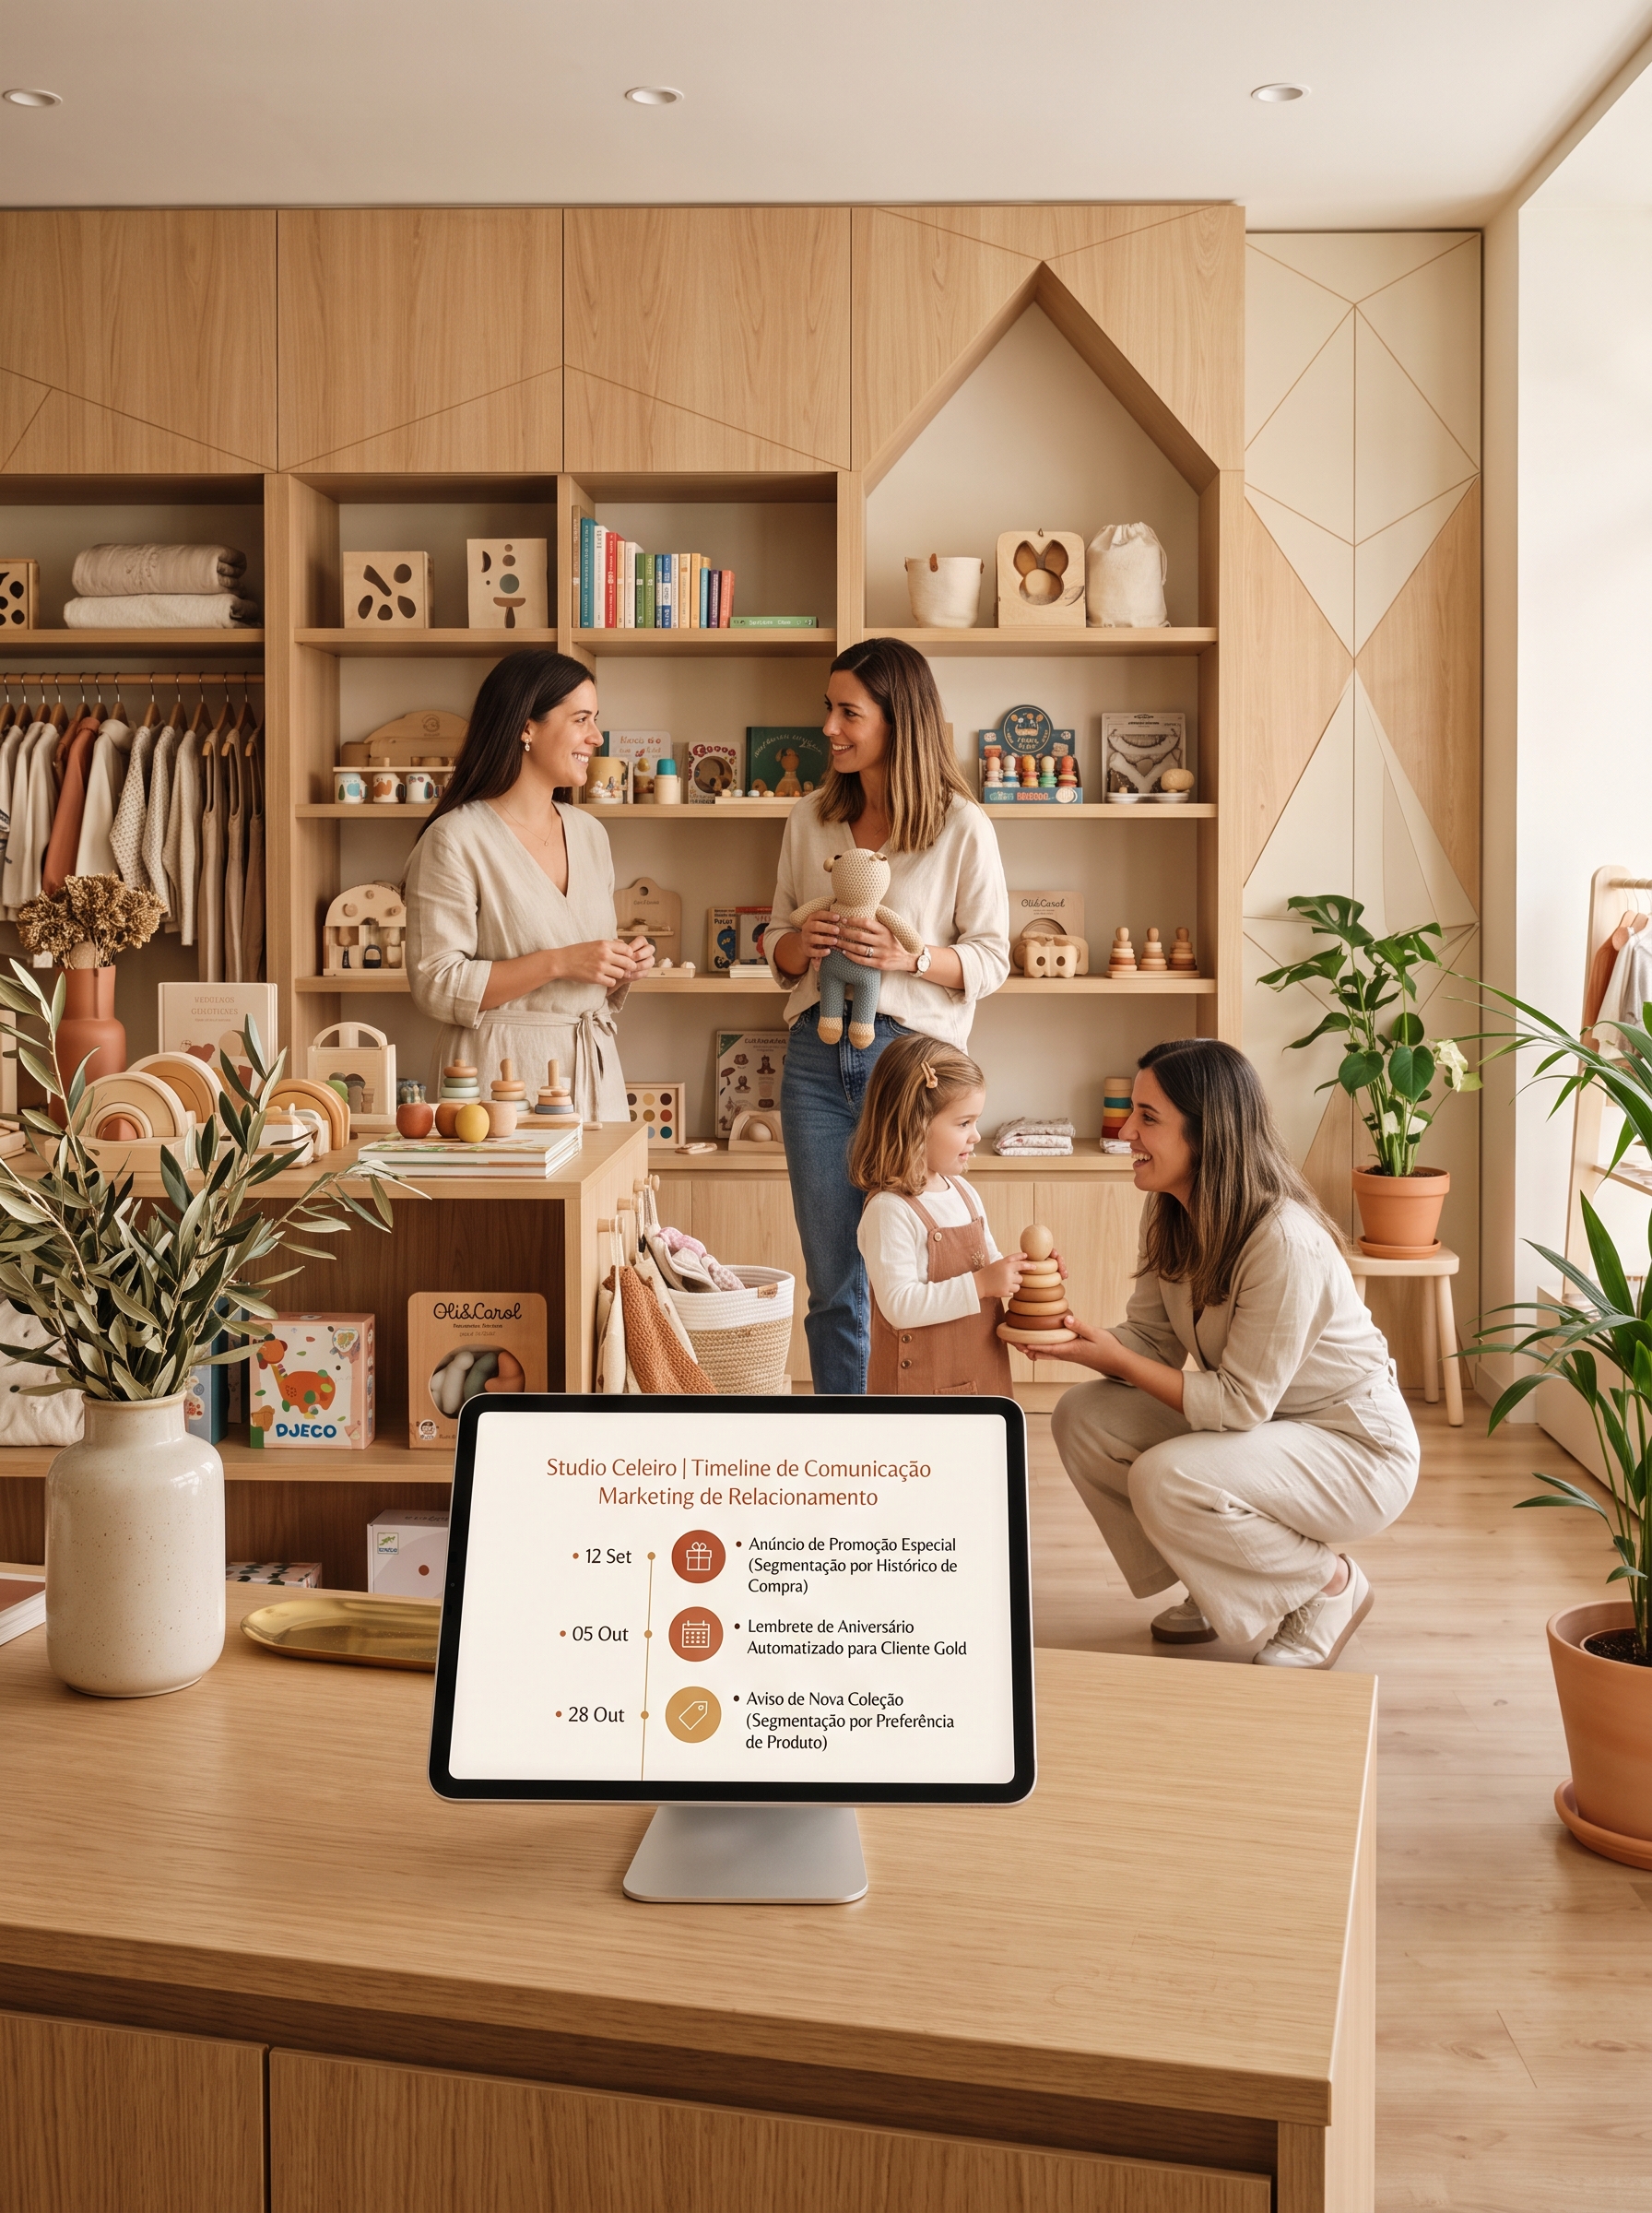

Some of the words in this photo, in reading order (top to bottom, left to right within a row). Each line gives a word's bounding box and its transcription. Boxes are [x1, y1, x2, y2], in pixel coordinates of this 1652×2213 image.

[433, 1302, 522, 1320] Oli&Carol
[276, 1423, 337, 1438] DJECO
[547, 1458, 607, 1477] Studio
[611, 1458, 678, 1477] Celeiro
[690, 1458, 772, 1477] Timeline
[776, 1459, 799, 1477] de
[804, 1459, 931, 1483] Comunicação
[598, 1486, 695, 1510] Marketing
[700, 1486, 723, 1506] de
[728, 1486, 879, 1506] Relacionamento
[749, 1536, 805, 1551] Anúncio
[808, 1536, 825, 1551] de
[829, 1537, 898, 1556] Promoção
[902, 1537, 956, 1556] Especial
[585, 1548, 602, 1564] 12
[606, 1548, 632, 1565] Set
[748, 1557, 846, 1576] (Segmentação
[850, 1561, 874, 1576] por
[877, 1557, 938, 1573] Histórico
[940, 1558, 958, 1573] de
[748, 1578, 808, 1597] Compra)
[572, 1626, 594, 1642] 05
[597, 1625, 630, 1642] Out
[748, 1618, 814, 1634] Lembrete
[817, 1618, 834, 1634] de
[837, 1618, 914, 1634] Aniversário
[747, 1639, 844, 1656] Automatizado
[847, 1644, 878, 1659] para
[880, 1639, 930, 1656] Cliente
[933, 1640, 967, 1656] Gold
[746, 1691, 785, 1706] Aviso
[787, 1691, 806, 1706] de
[808, 1691, 844, 1707] Nova
[847, 1691, 904, 1710] Coleção
[568, 1706, 589, 1722] 28
[593, 1706, 625, 1723] Out
[746, 1712, 846, 1732] (Segmentação
[849, 1717, 873, 1732] por
[876, 1712, 955, 1729] Preferência
[745, 1734, 763, 1749] de
[767, 1734, 828, 1752] Produto)
